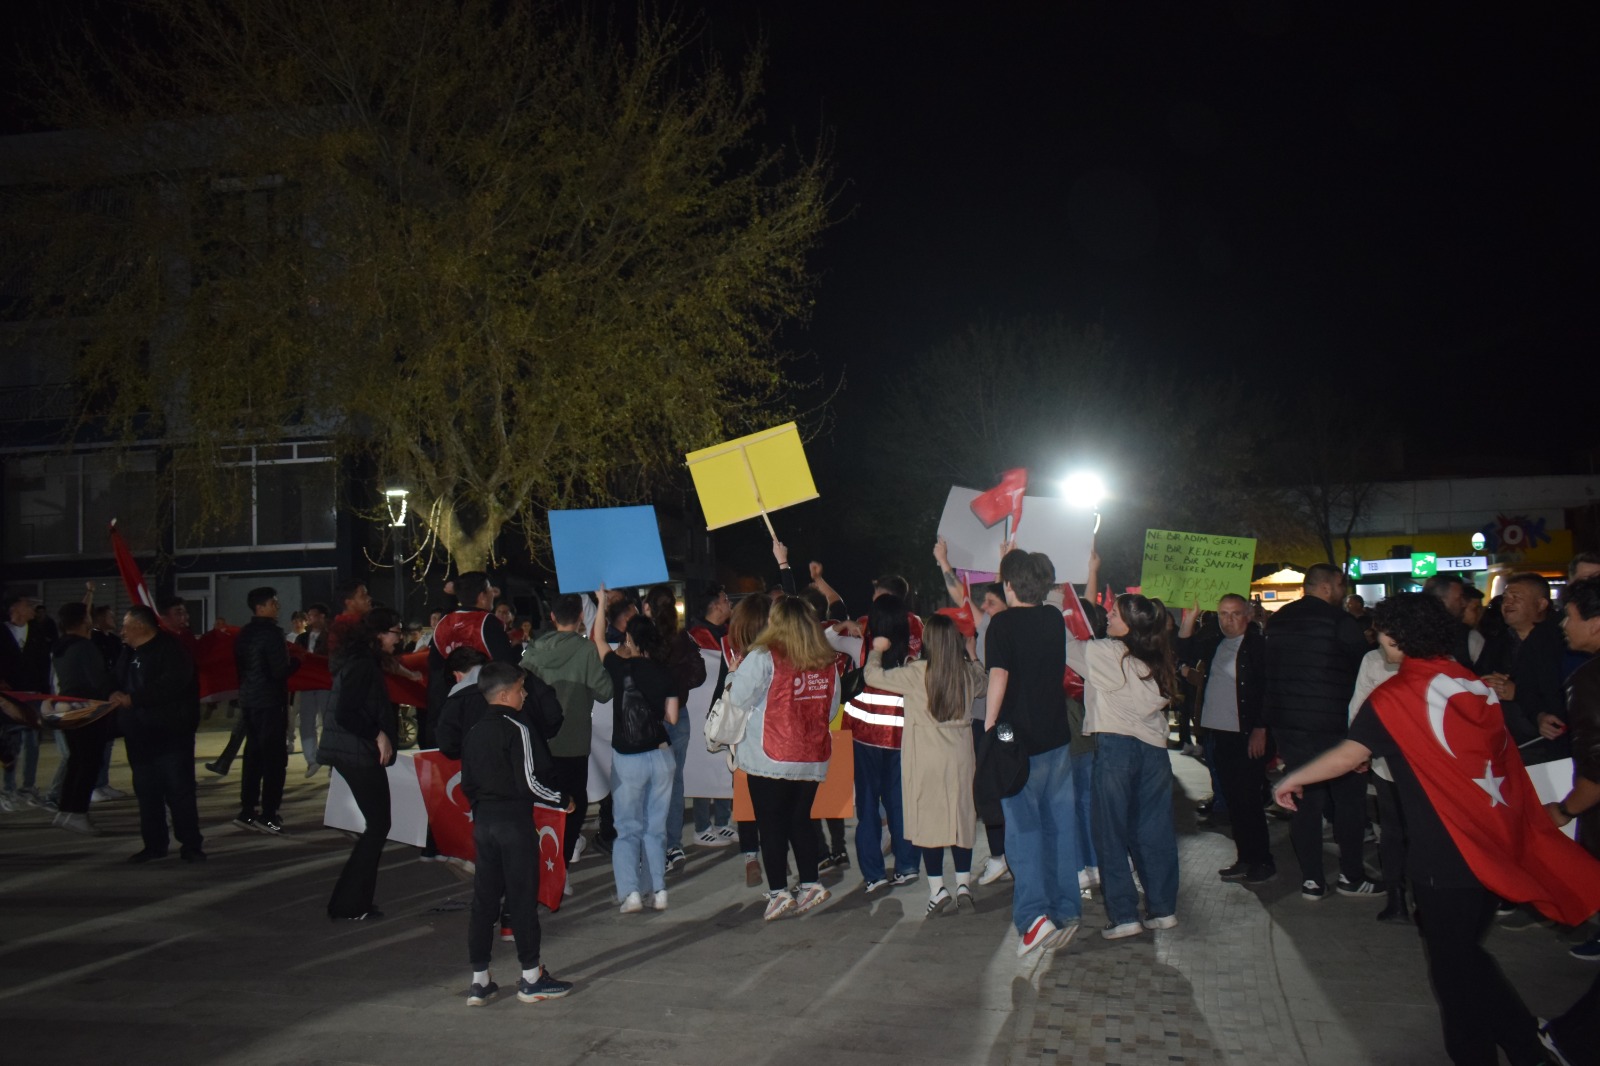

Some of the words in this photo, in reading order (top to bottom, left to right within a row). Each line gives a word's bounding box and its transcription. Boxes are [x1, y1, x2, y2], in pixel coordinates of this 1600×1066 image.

[1147, 531, 1162, 539] NE
[1184, 534, 1209, 544] ADIM
[1144, 553, 1159, 561] NE
[1163, 554, 1175, 562] DE
[1367, 562, 1379, 571] TEB
[1446, 558, 1472, 568] TEB
